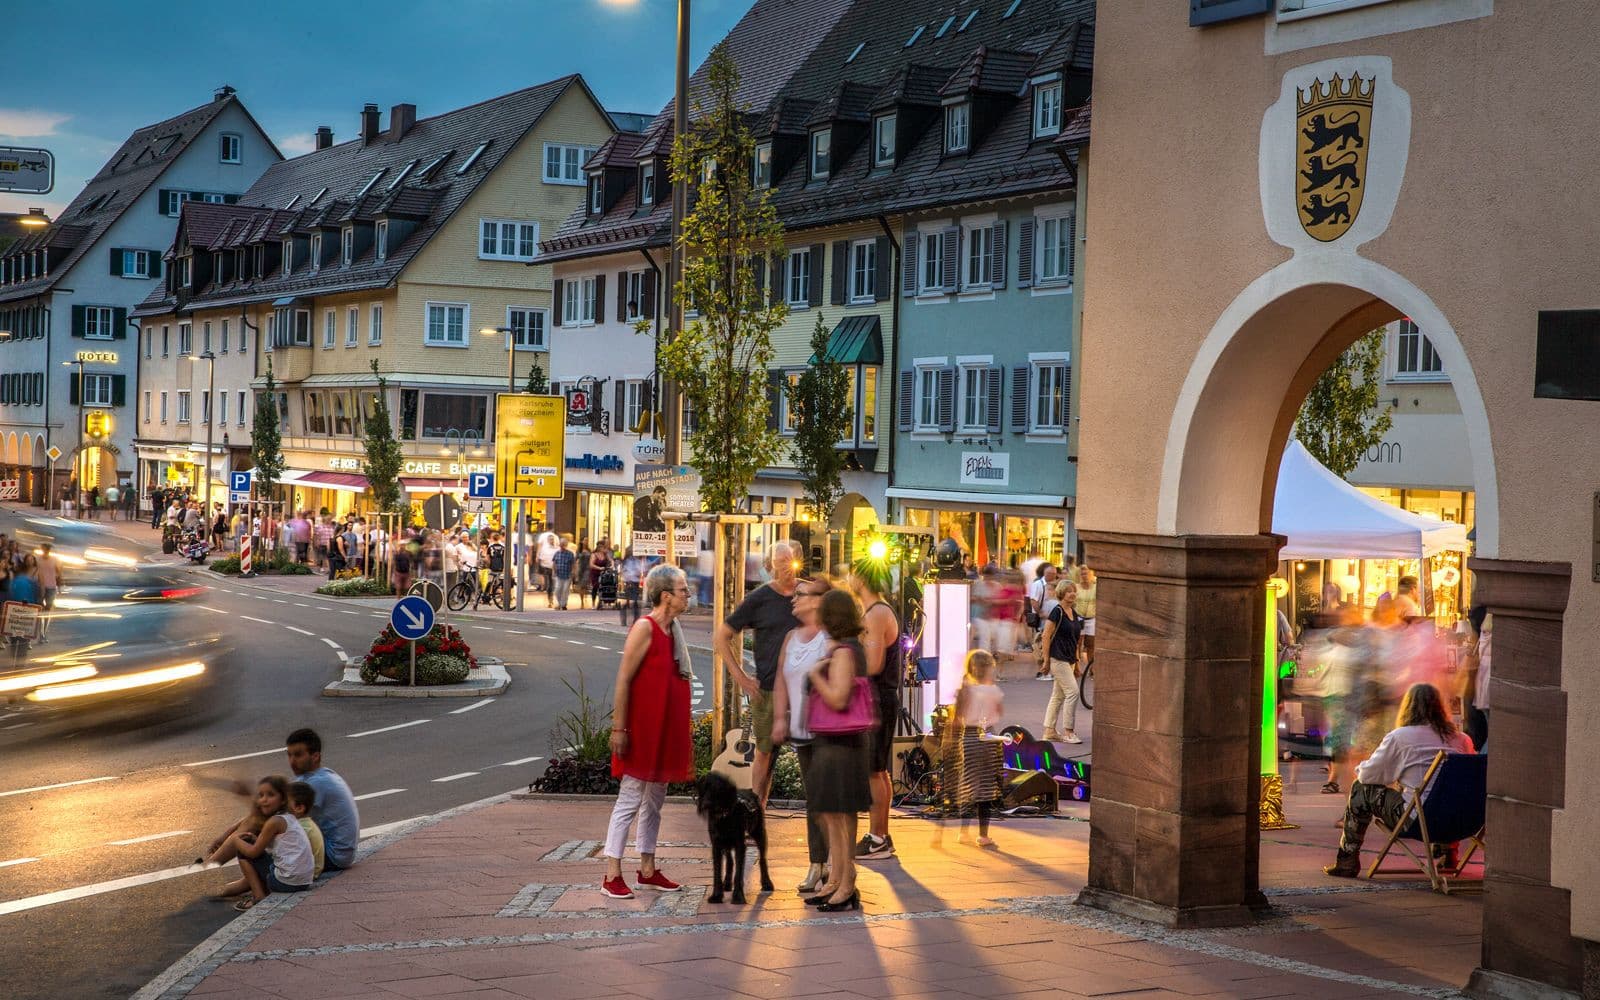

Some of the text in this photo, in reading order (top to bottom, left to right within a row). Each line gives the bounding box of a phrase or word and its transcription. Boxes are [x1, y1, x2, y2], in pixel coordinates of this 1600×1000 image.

[79, 352, 117, 361] HOTEL
[405, 462, 441, 474] CAFE
[636, 468, 672, 481] AUF NACH
